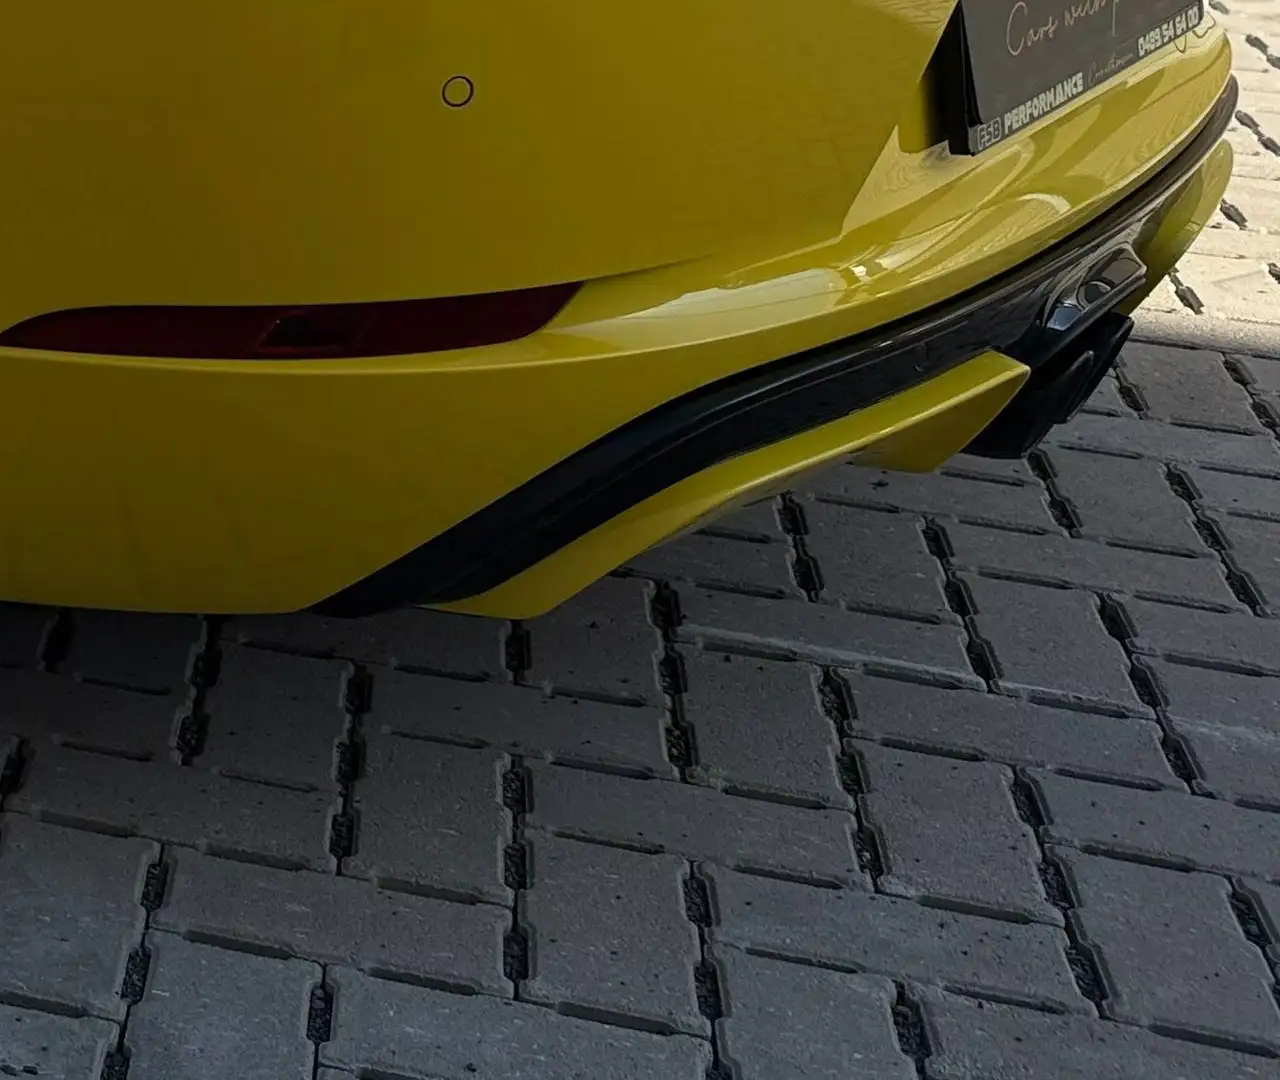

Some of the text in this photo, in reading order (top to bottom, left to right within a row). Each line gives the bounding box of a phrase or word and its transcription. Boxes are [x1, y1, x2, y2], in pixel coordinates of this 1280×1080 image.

[1006, 1, 1059, 56] Cars
[1161, 20, 1175, 43] 54
[1186, 4, 1200, 30] 00
[977, 71, 1084, 150] FSB PERFORMANCE
